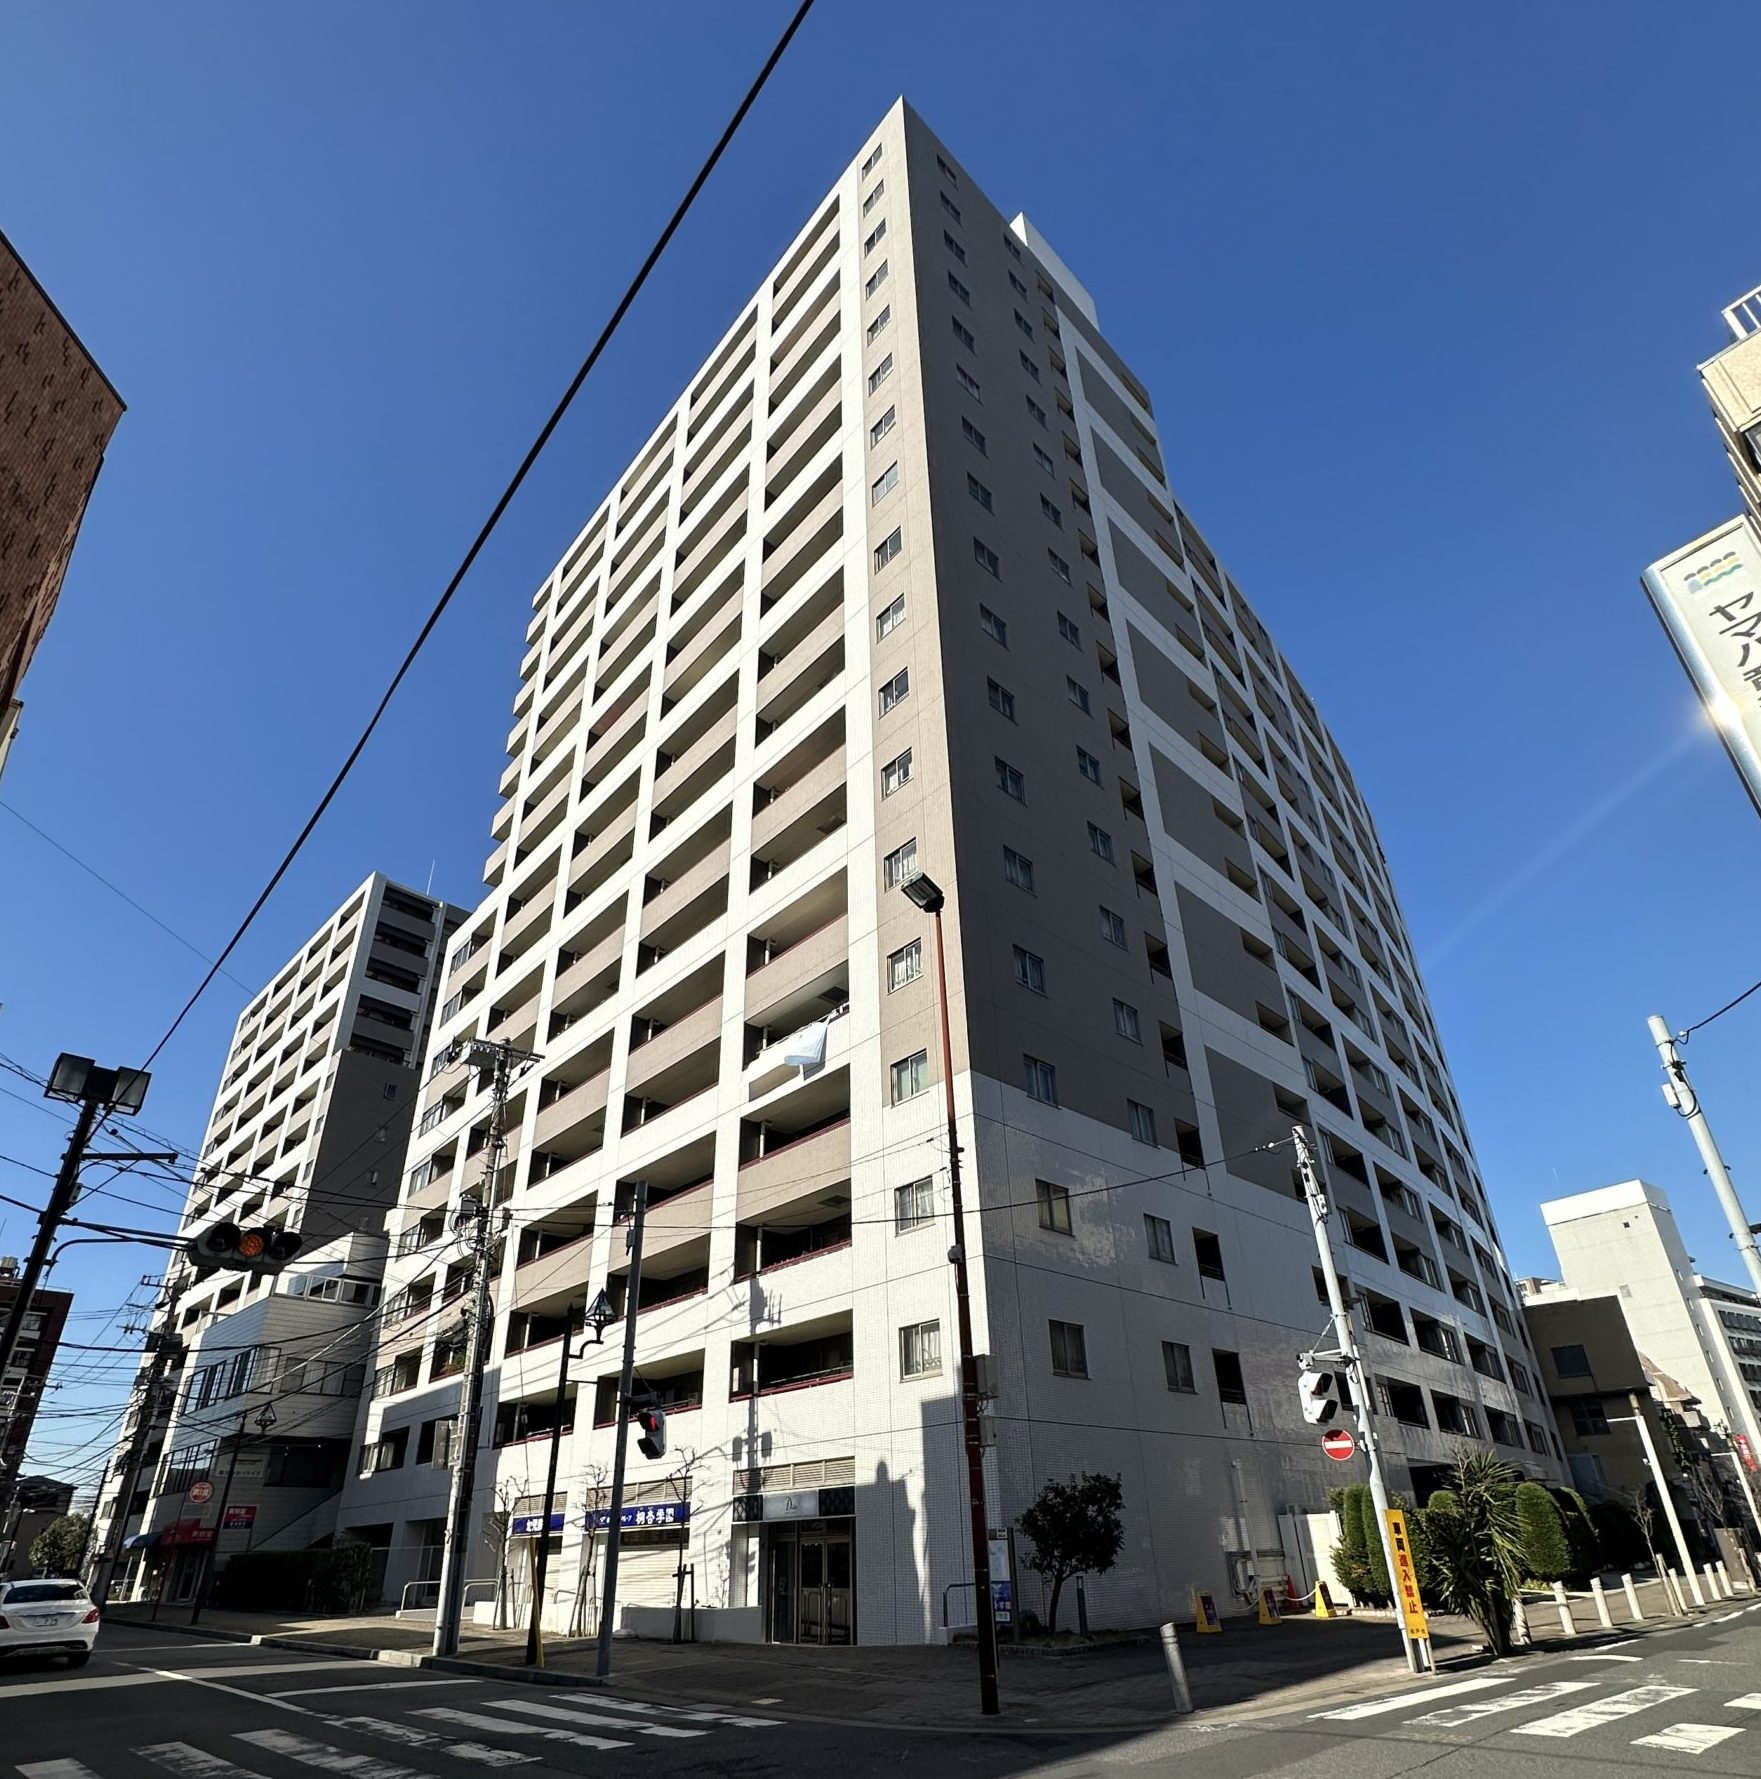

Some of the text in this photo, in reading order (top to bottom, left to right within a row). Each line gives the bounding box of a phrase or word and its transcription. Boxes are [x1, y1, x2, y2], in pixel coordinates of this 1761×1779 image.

[1663, 1411, 1690, 1467] PIZZERIA
[1392, 1521, 1418, 1614] 車両進入禁止
